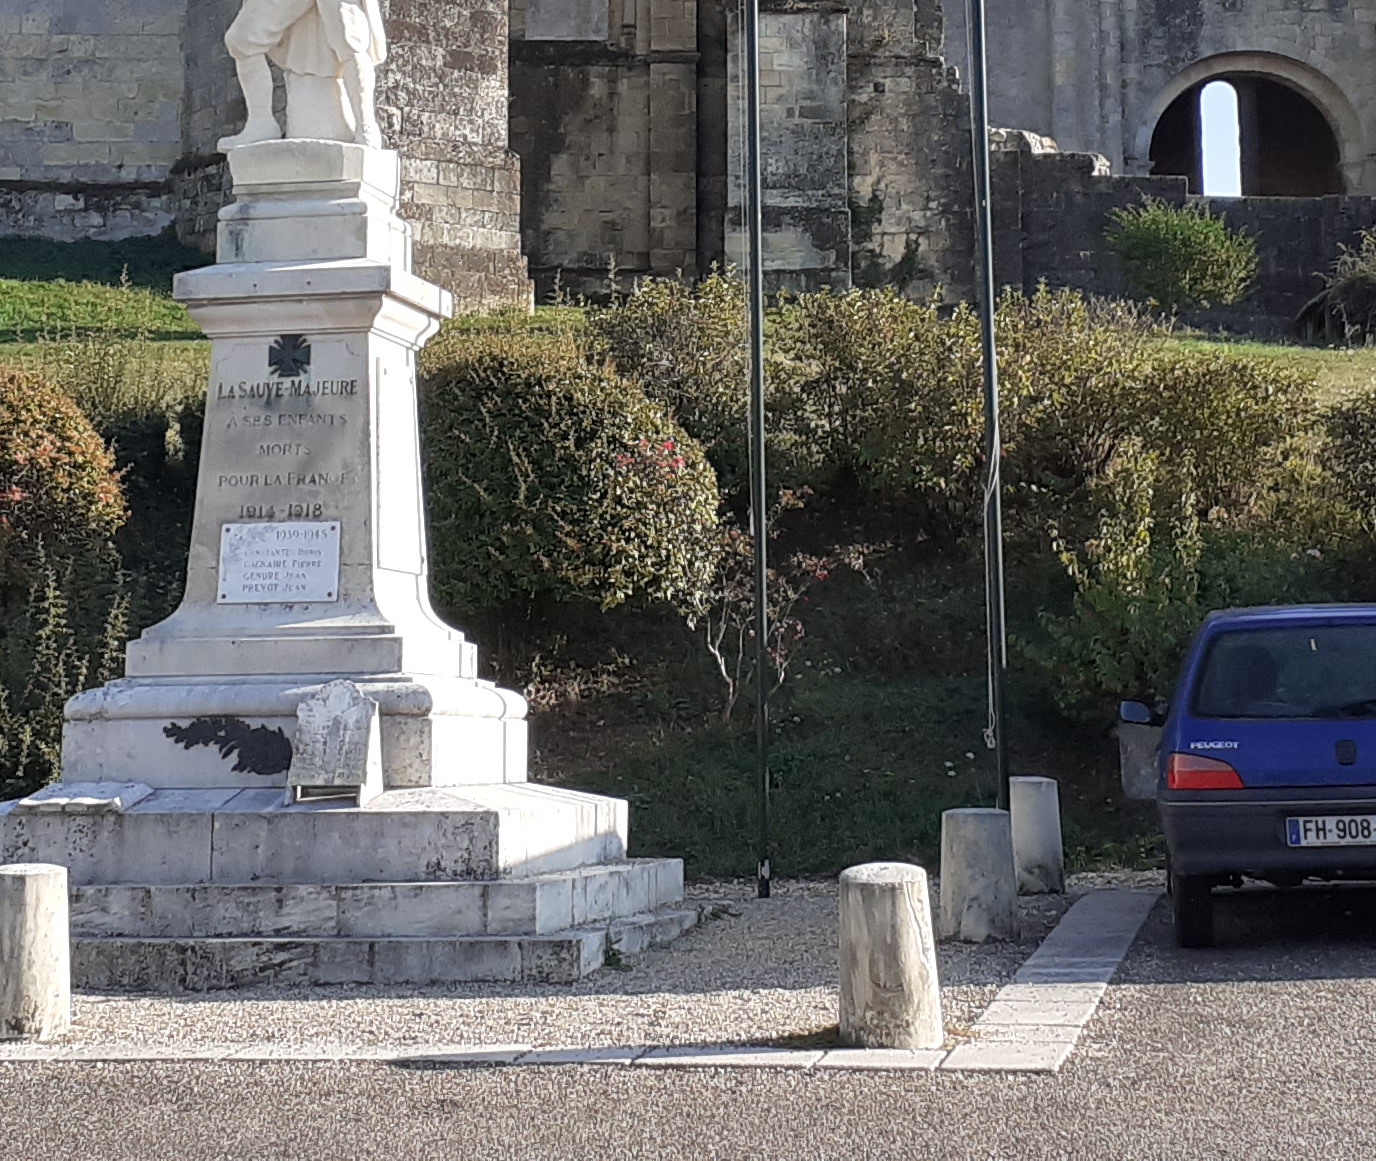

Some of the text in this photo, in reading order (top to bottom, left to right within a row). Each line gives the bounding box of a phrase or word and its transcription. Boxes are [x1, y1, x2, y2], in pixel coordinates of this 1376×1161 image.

[217, 382, 236, 399] LA
[242, 414, 272, 427] SES
[278, 413, 348, 426] ENFANTS
[258, 443, 311, 456] MORTS
[218, 471, 346, 487] POUR LA FRANE
[292, 559, 322, 568] PIERRE
[284, 571, 307, 580] JEAN
[283, 583, 306, 592] JEAN
[1190, 741, 1240, 749] PEUGEOT
